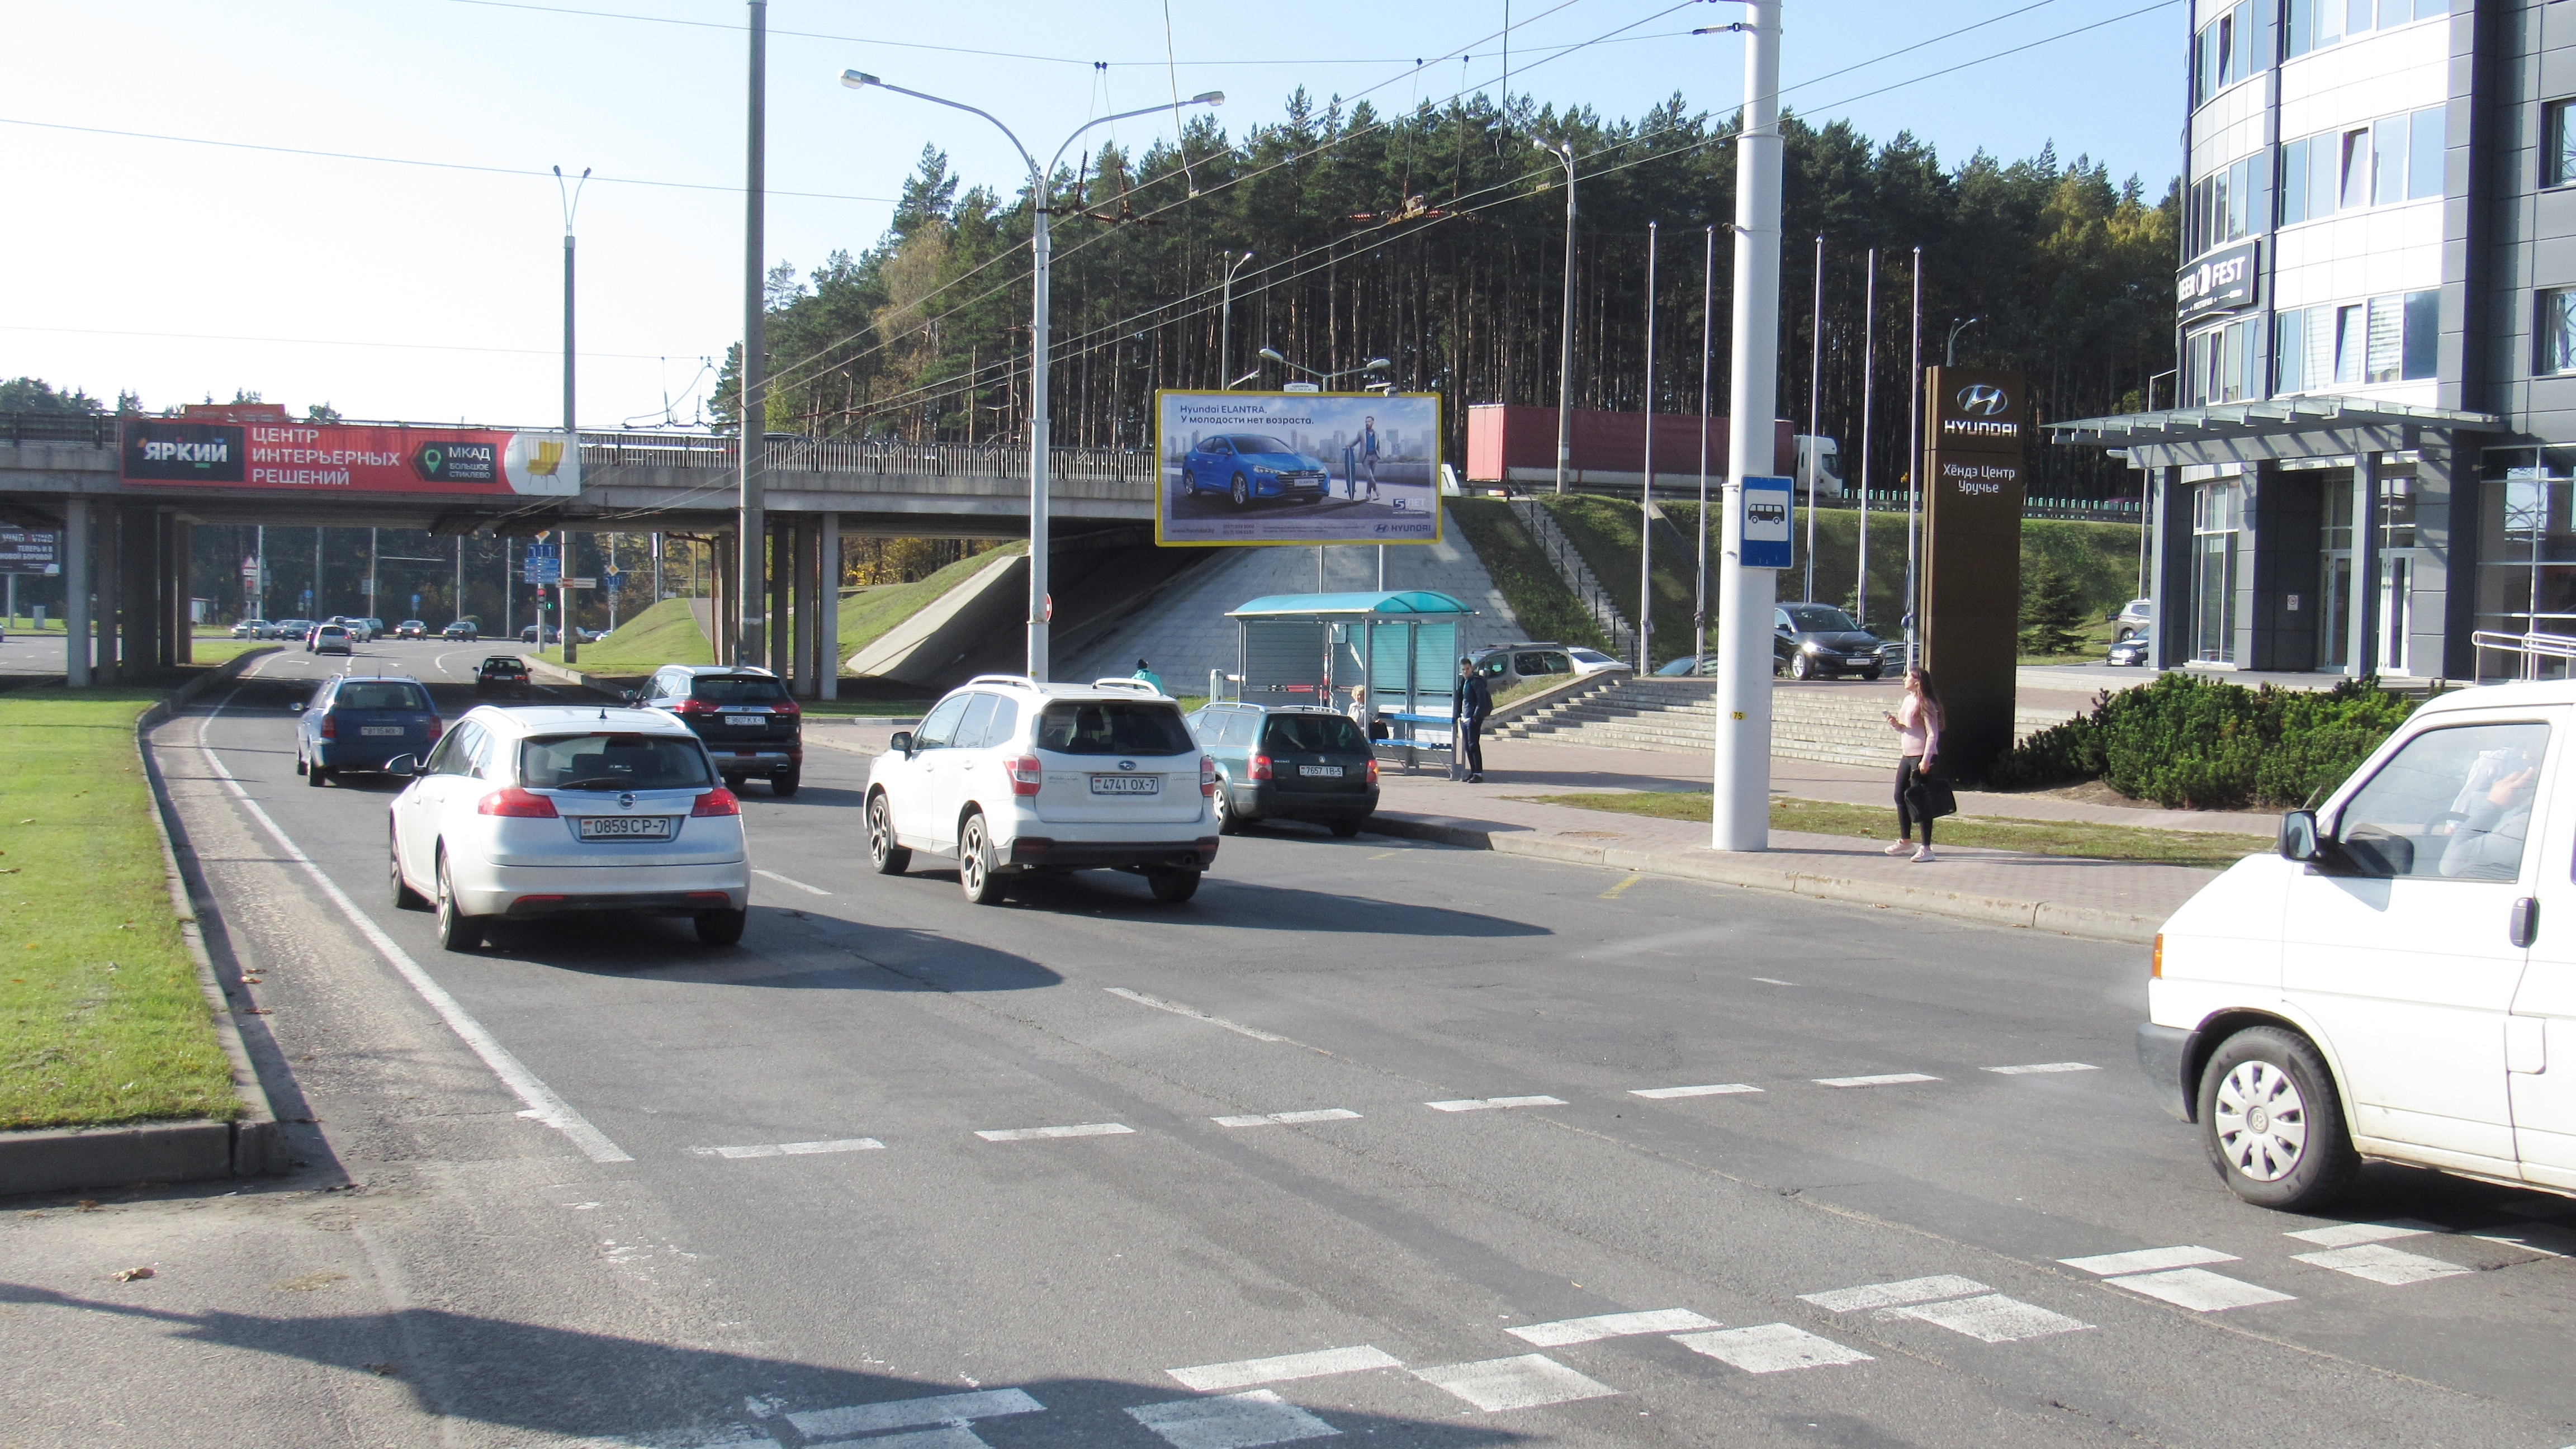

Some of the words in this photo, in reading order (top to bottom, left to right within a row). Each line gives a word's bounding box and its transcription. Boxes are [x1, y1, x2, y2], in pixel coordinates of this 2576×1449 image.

[2212, 256, 2246, 287] FEST
[1180, 405, 1219, 414] Hyundai
[253, 427, 319, 444] ЦЕНТР
[1944, 420, 2017, 437] HYUNDAI
[144, 438, 228, 462] ЯРКИЙ
[253, 448, 400, 466] ИНТЕРЬЕРНЫХ
[449, 447, 491, 461] МКАД
[253, 467, 349, 485] РЕШЕНИЙ
[1943, 463, 1977, 479] Хёндэ
[1981, 466, 2015, 481] Центр
[1959, 480, 1999, 495] Уручье
[1393, 499, 1405, 510] 5
[1407, 498, 1426, 506] ЛЕТ
[1104, 779, 1126, 790] 4741
[1130, 779, 1156, 790] OX-7
[595, 820, 628, 834] 0859
[631, 820, 666, 834] CP-7
